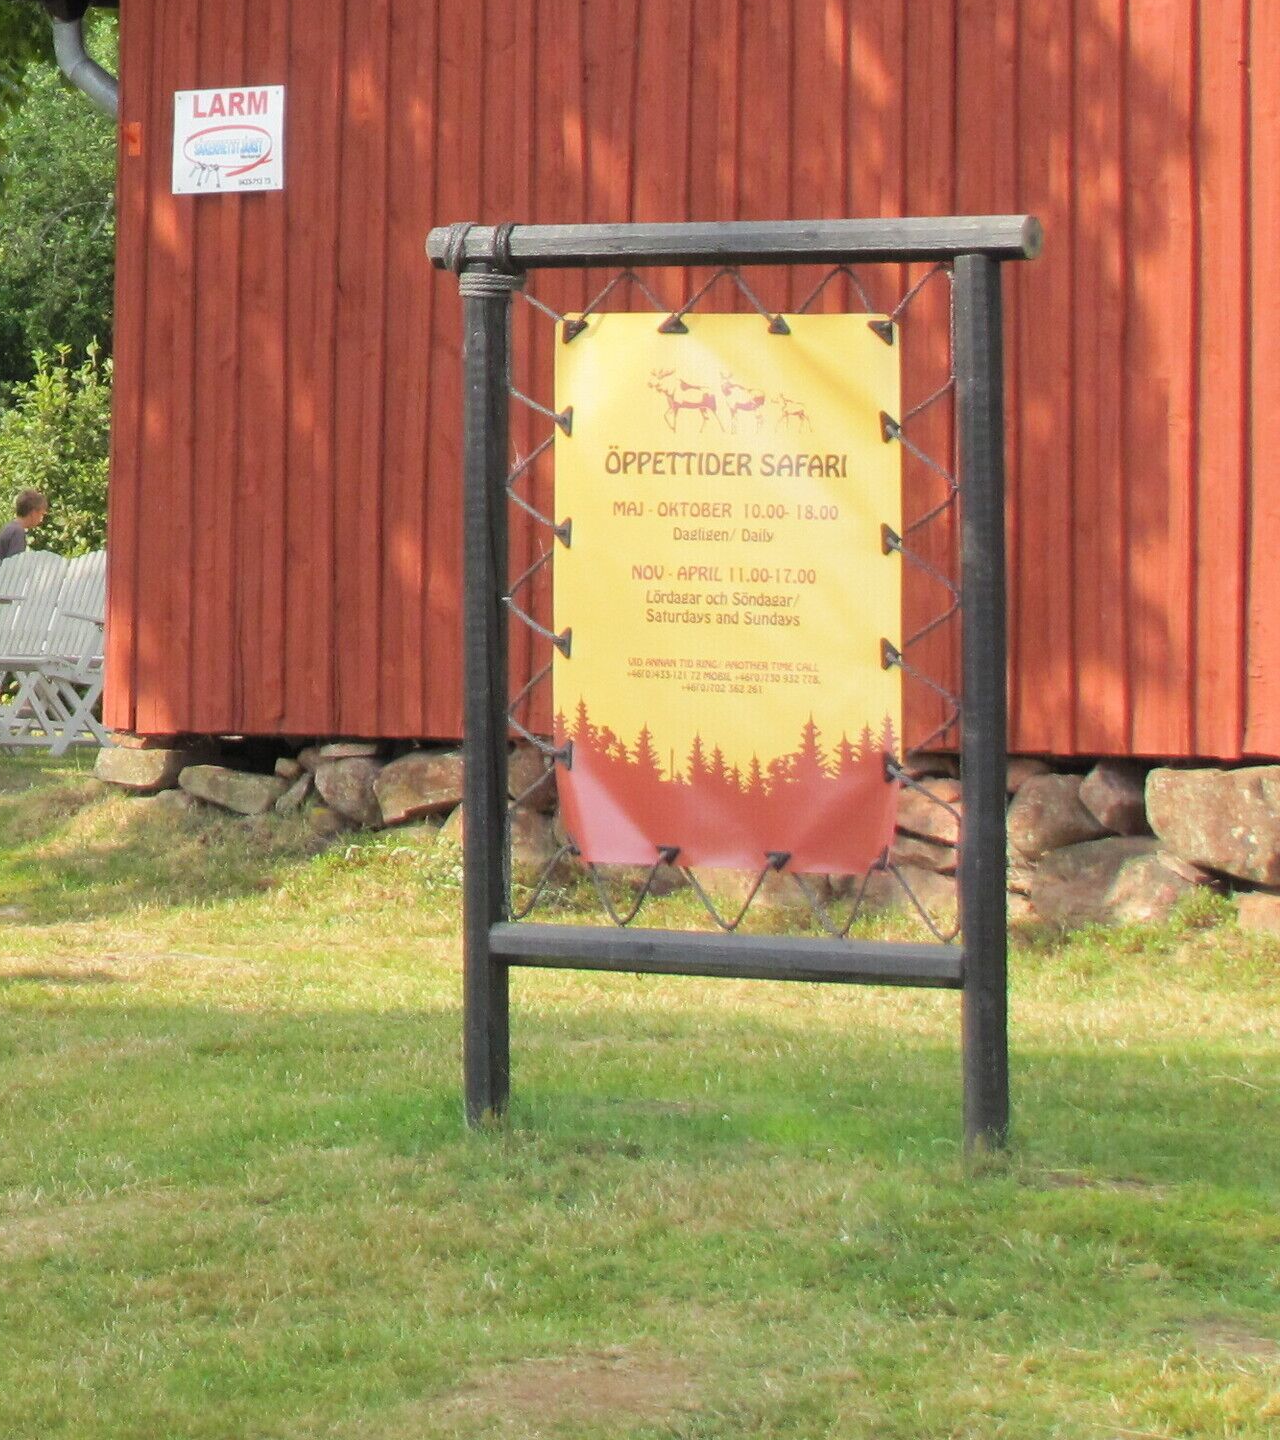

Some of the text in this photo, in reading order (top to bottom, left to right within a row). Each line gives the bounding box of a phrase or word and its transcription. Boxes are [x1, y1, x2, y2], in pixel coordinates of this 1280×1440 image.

[192, 90, 268, 118] LARM
[605, 445, 847, 478] ÖPPETTIDER SAFARI
[613, 501, 644, 517] MAJ
[657, 502, 732, 518] OKTOBER
[797, 504, 839, 521] 18.00
[741, 528, 774, 543] Daily
[631, 565, 664, 580] NOV
[677, 566, 723, 582] APRIL
[729, 567, 816, 584] 11.00-17.00
[646, 590, 701, 605] Lördagar
[706, 592, 728, 605] och
[646, 608, 800, 627] Saturdays and Sundays
[724, 660, 768, 671] ANOTHER
[795, 662, 819, 672] CALL
